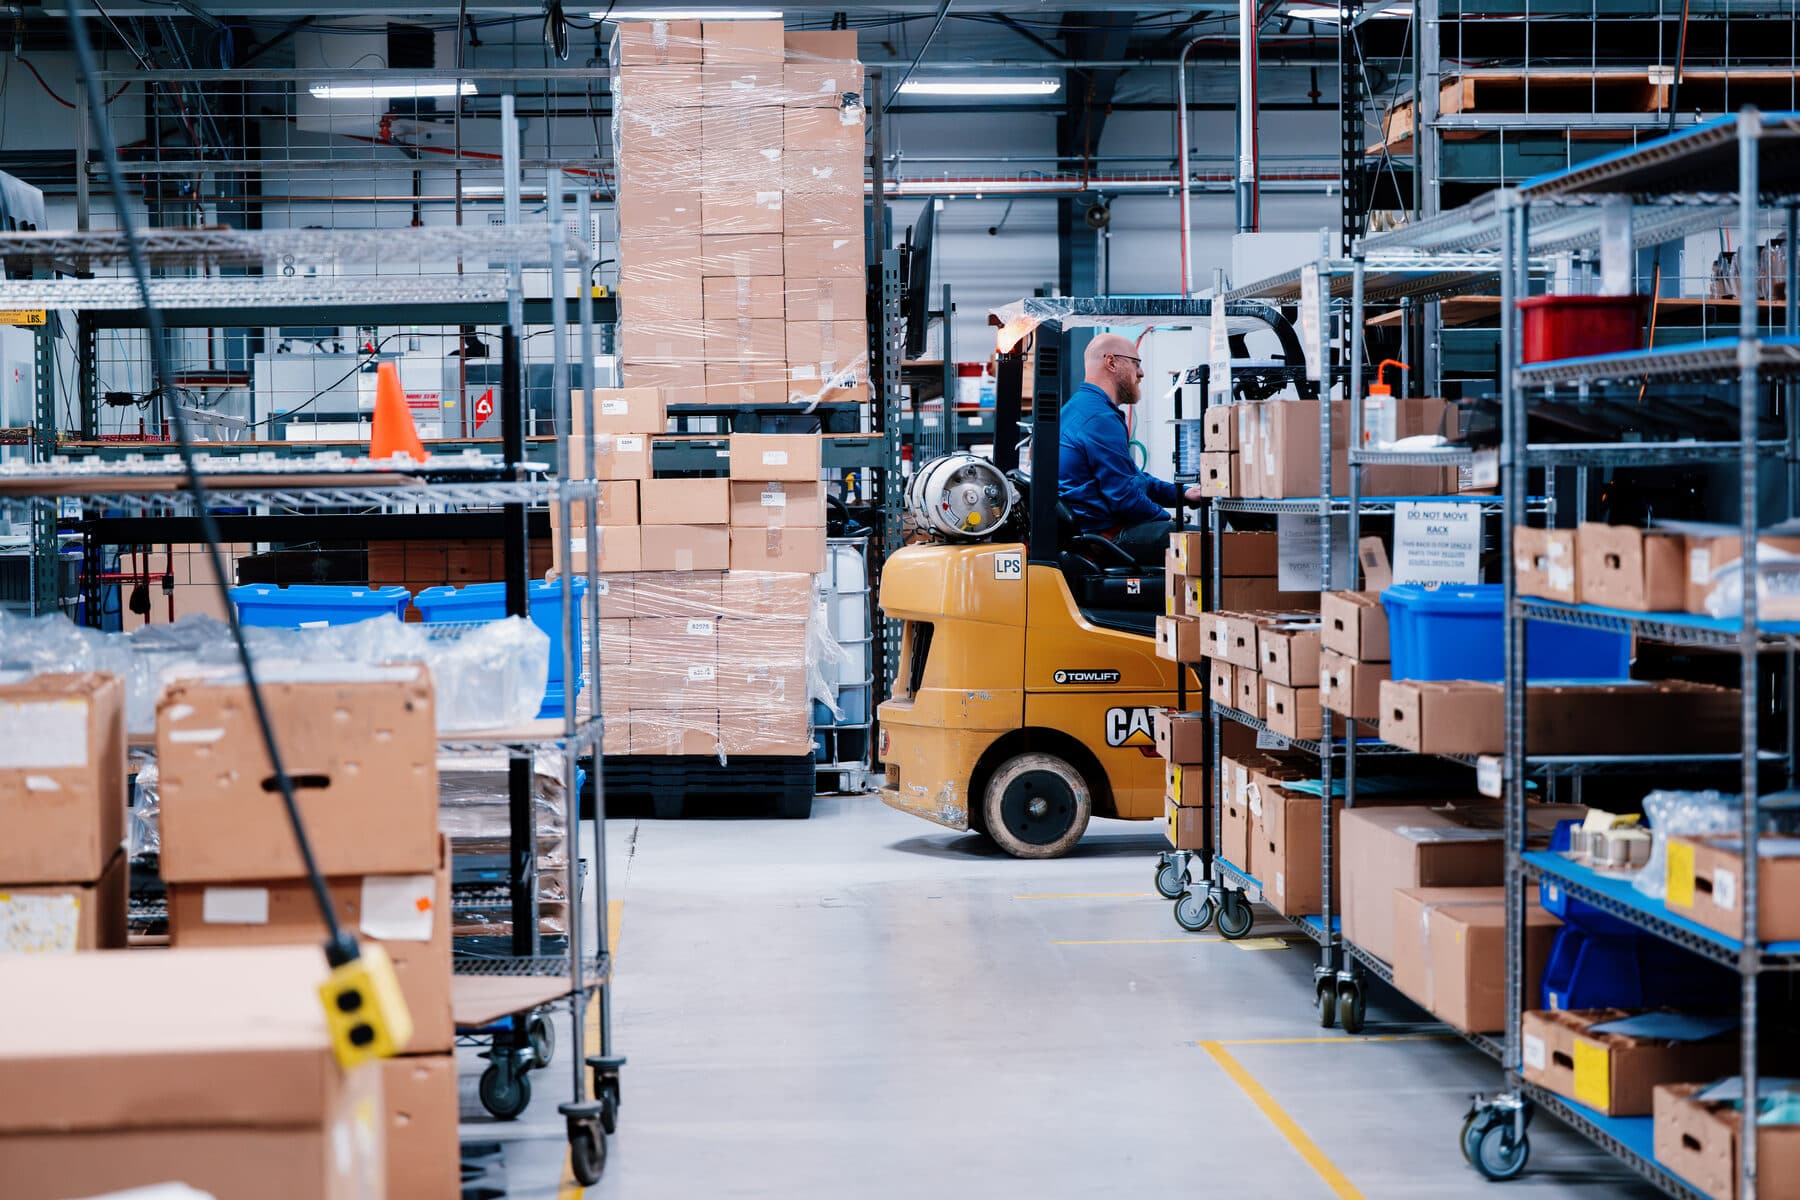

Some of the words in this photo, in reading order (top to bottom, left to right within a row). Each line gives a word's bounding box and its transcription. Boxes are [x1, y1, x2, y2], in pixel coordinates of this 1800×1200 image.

[27, 314, 42, 323] LBS.
[1407, 510, 1420, 520] DO
[1423, 511, 1440, 520] NOT
[1443, 511, 1468, 521] MOVE
[1426, 526, 1448, 535] RACK
[996, 559, 1020, 573] LPS
[1067, 672, 1119, 681] TOWLIFT
[1106, 707, 1168, 746] CAT
